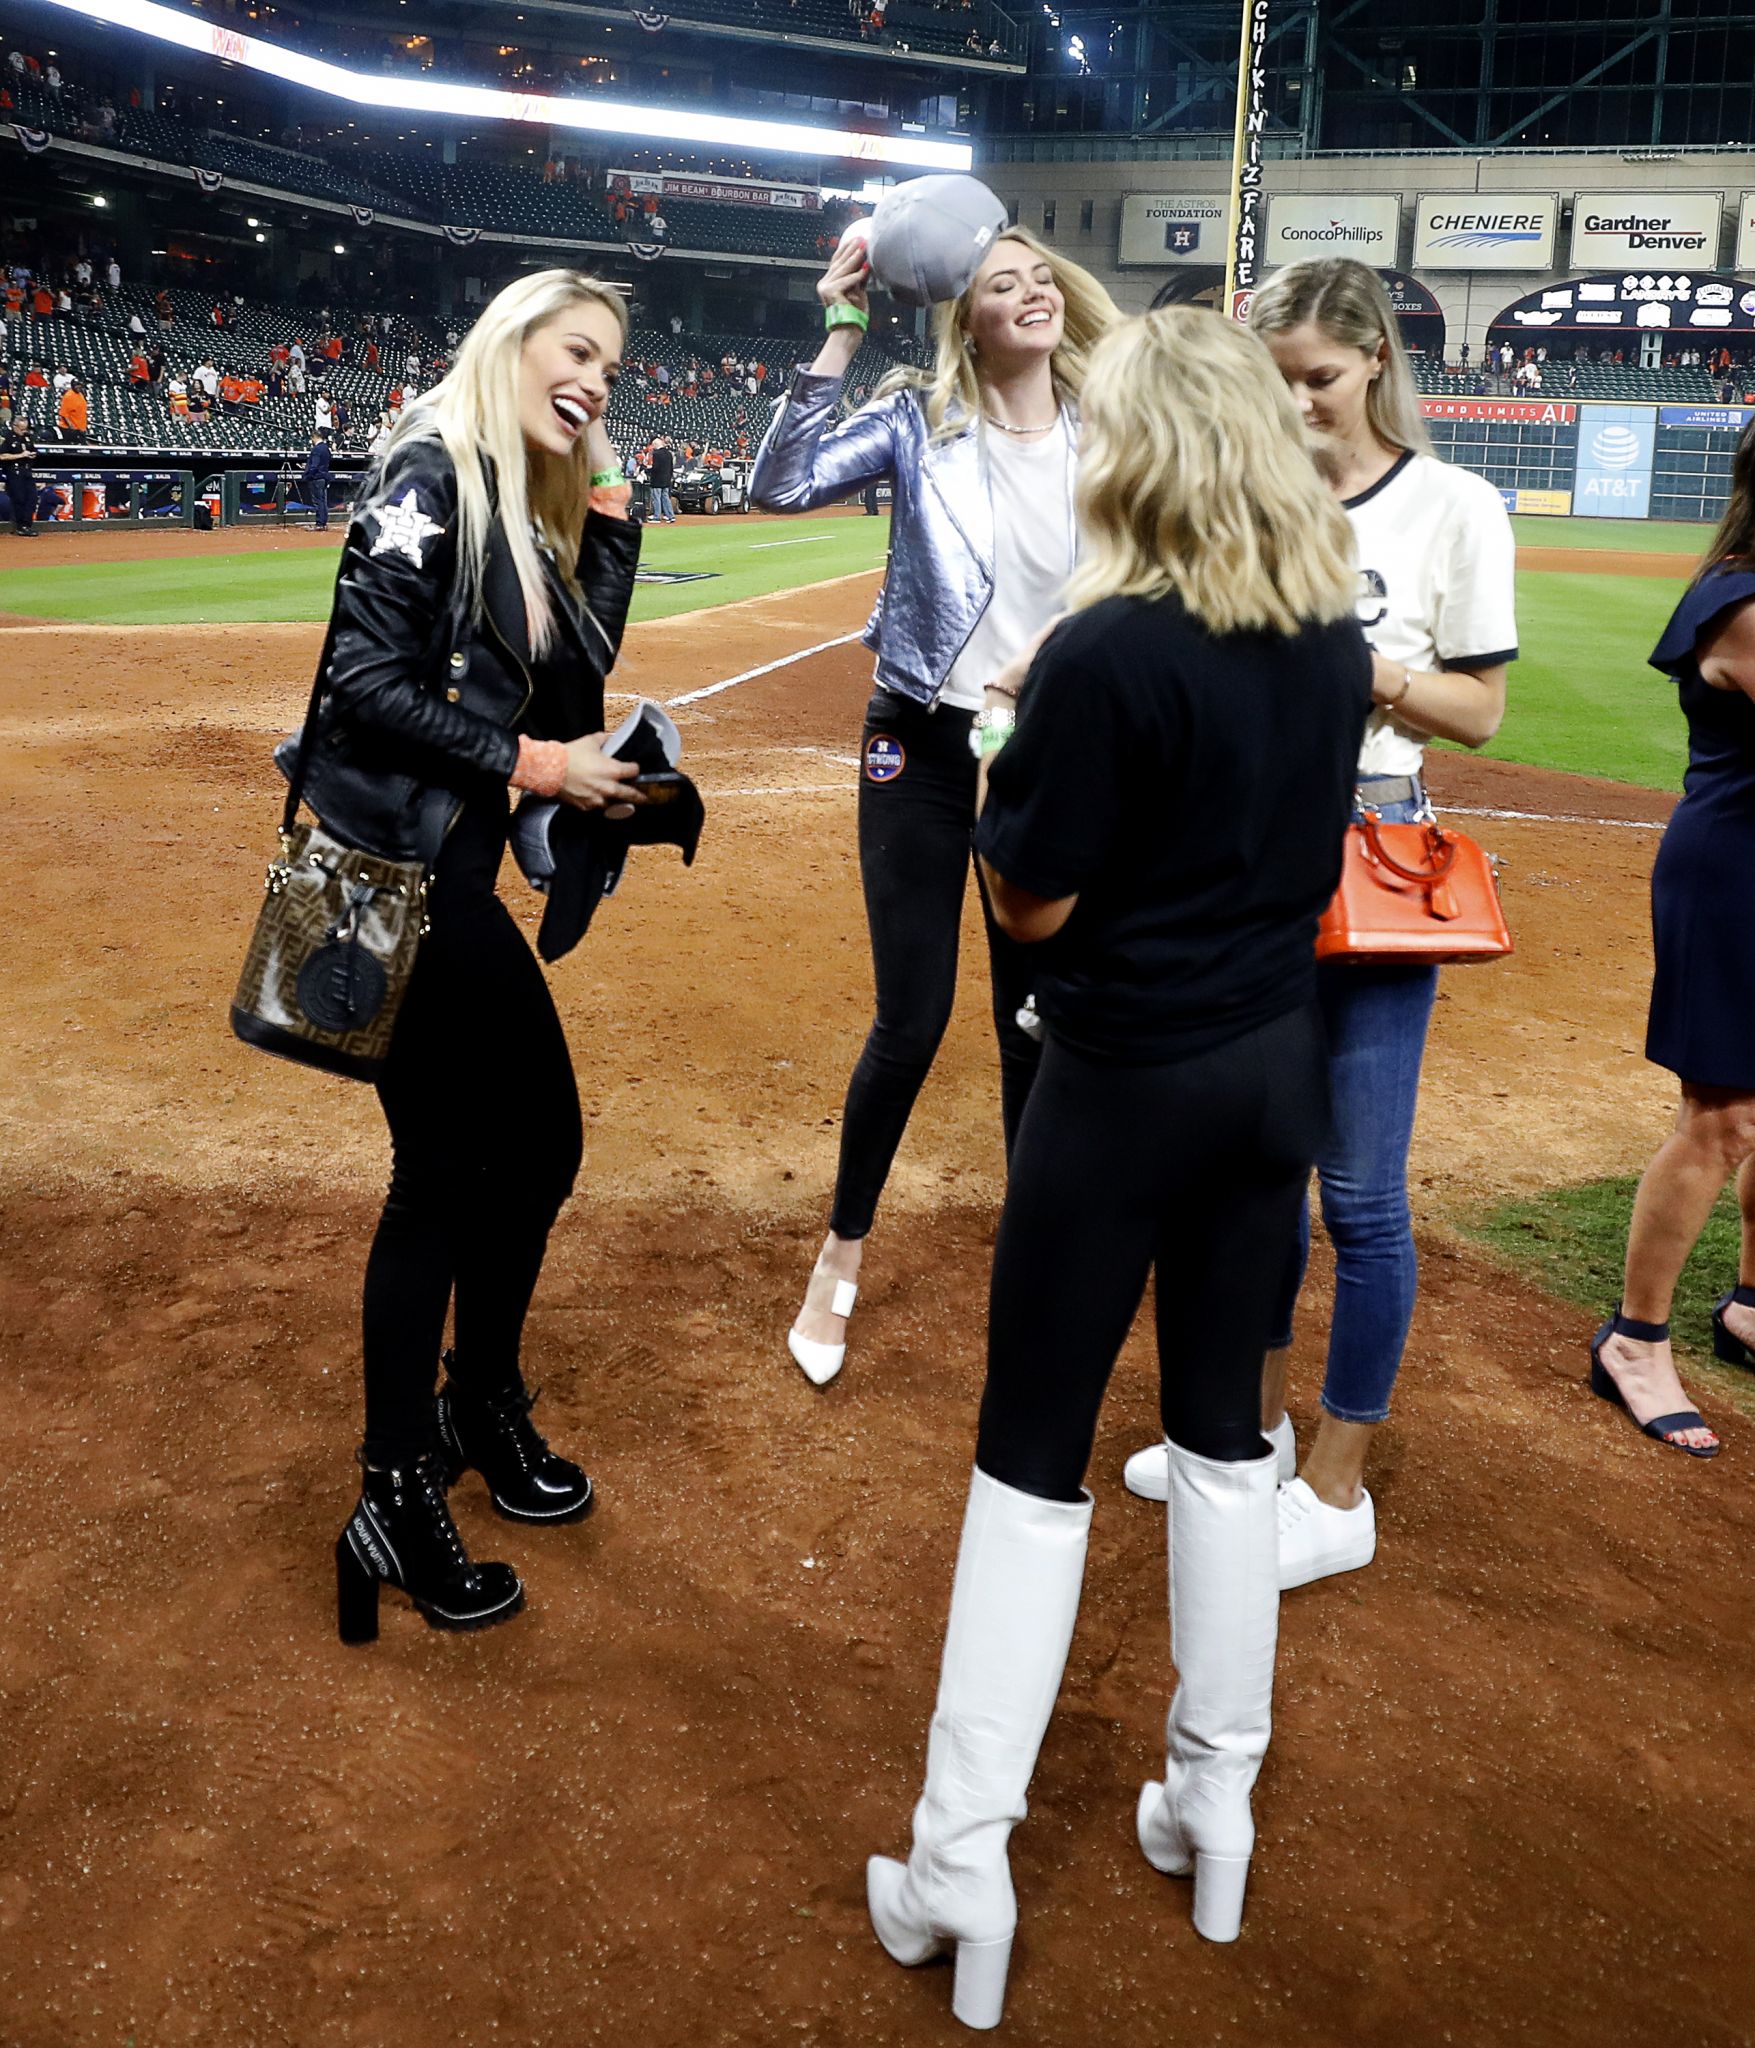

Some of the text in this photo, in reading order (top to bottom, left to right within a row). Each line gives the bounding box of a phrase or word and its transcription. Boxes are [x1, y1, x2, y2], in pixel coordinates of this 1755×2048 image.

[213, 27, 247, 61] WIN
[665, 183, 679, 192] JIM
[711, 187, 750, 200] BOURBON
[752, 192, 769, 202] BAR
[1154, 200, 1216, 208] THE ASTROS
[1146, 209, 1222, 218] FOUNDATION
[1429, 215, 1544, 230] CHENIERE
[1585, 215, 1671, 231] Gardner
[1238, 192, 1258, 285] FARE
[1281, 226, 1383, 244] ConocoPhillips
[1628, 233, 1706, 249] Denver
[1424, 404, 1468, 414] YOND
[1477, 406, 1537, 416] LIMITS
[1584, 478, 1642, 497] AT&T
[867, 753, 901, 766] STRONG
[353, 1515, 372, 1546] LOUIS
